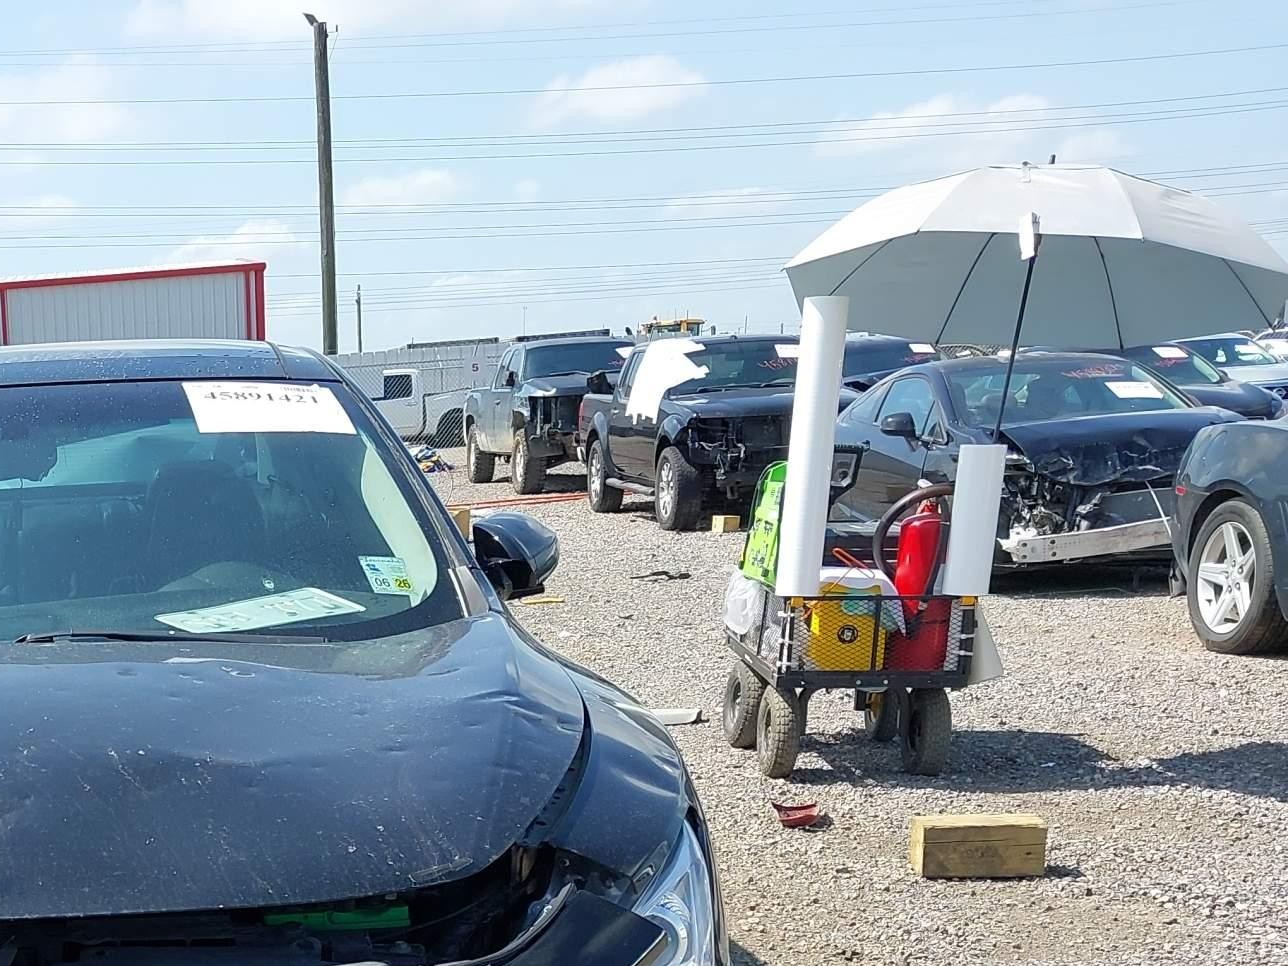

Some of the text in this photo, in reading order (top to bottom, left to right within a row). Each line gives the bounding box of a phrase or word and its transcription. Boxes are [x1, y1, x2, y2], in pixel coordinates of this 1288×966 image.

[472, 363, 480, 372] 5
[204, 391, 318, 404] 45891421
[374, 578, 411, 589] 06 26
